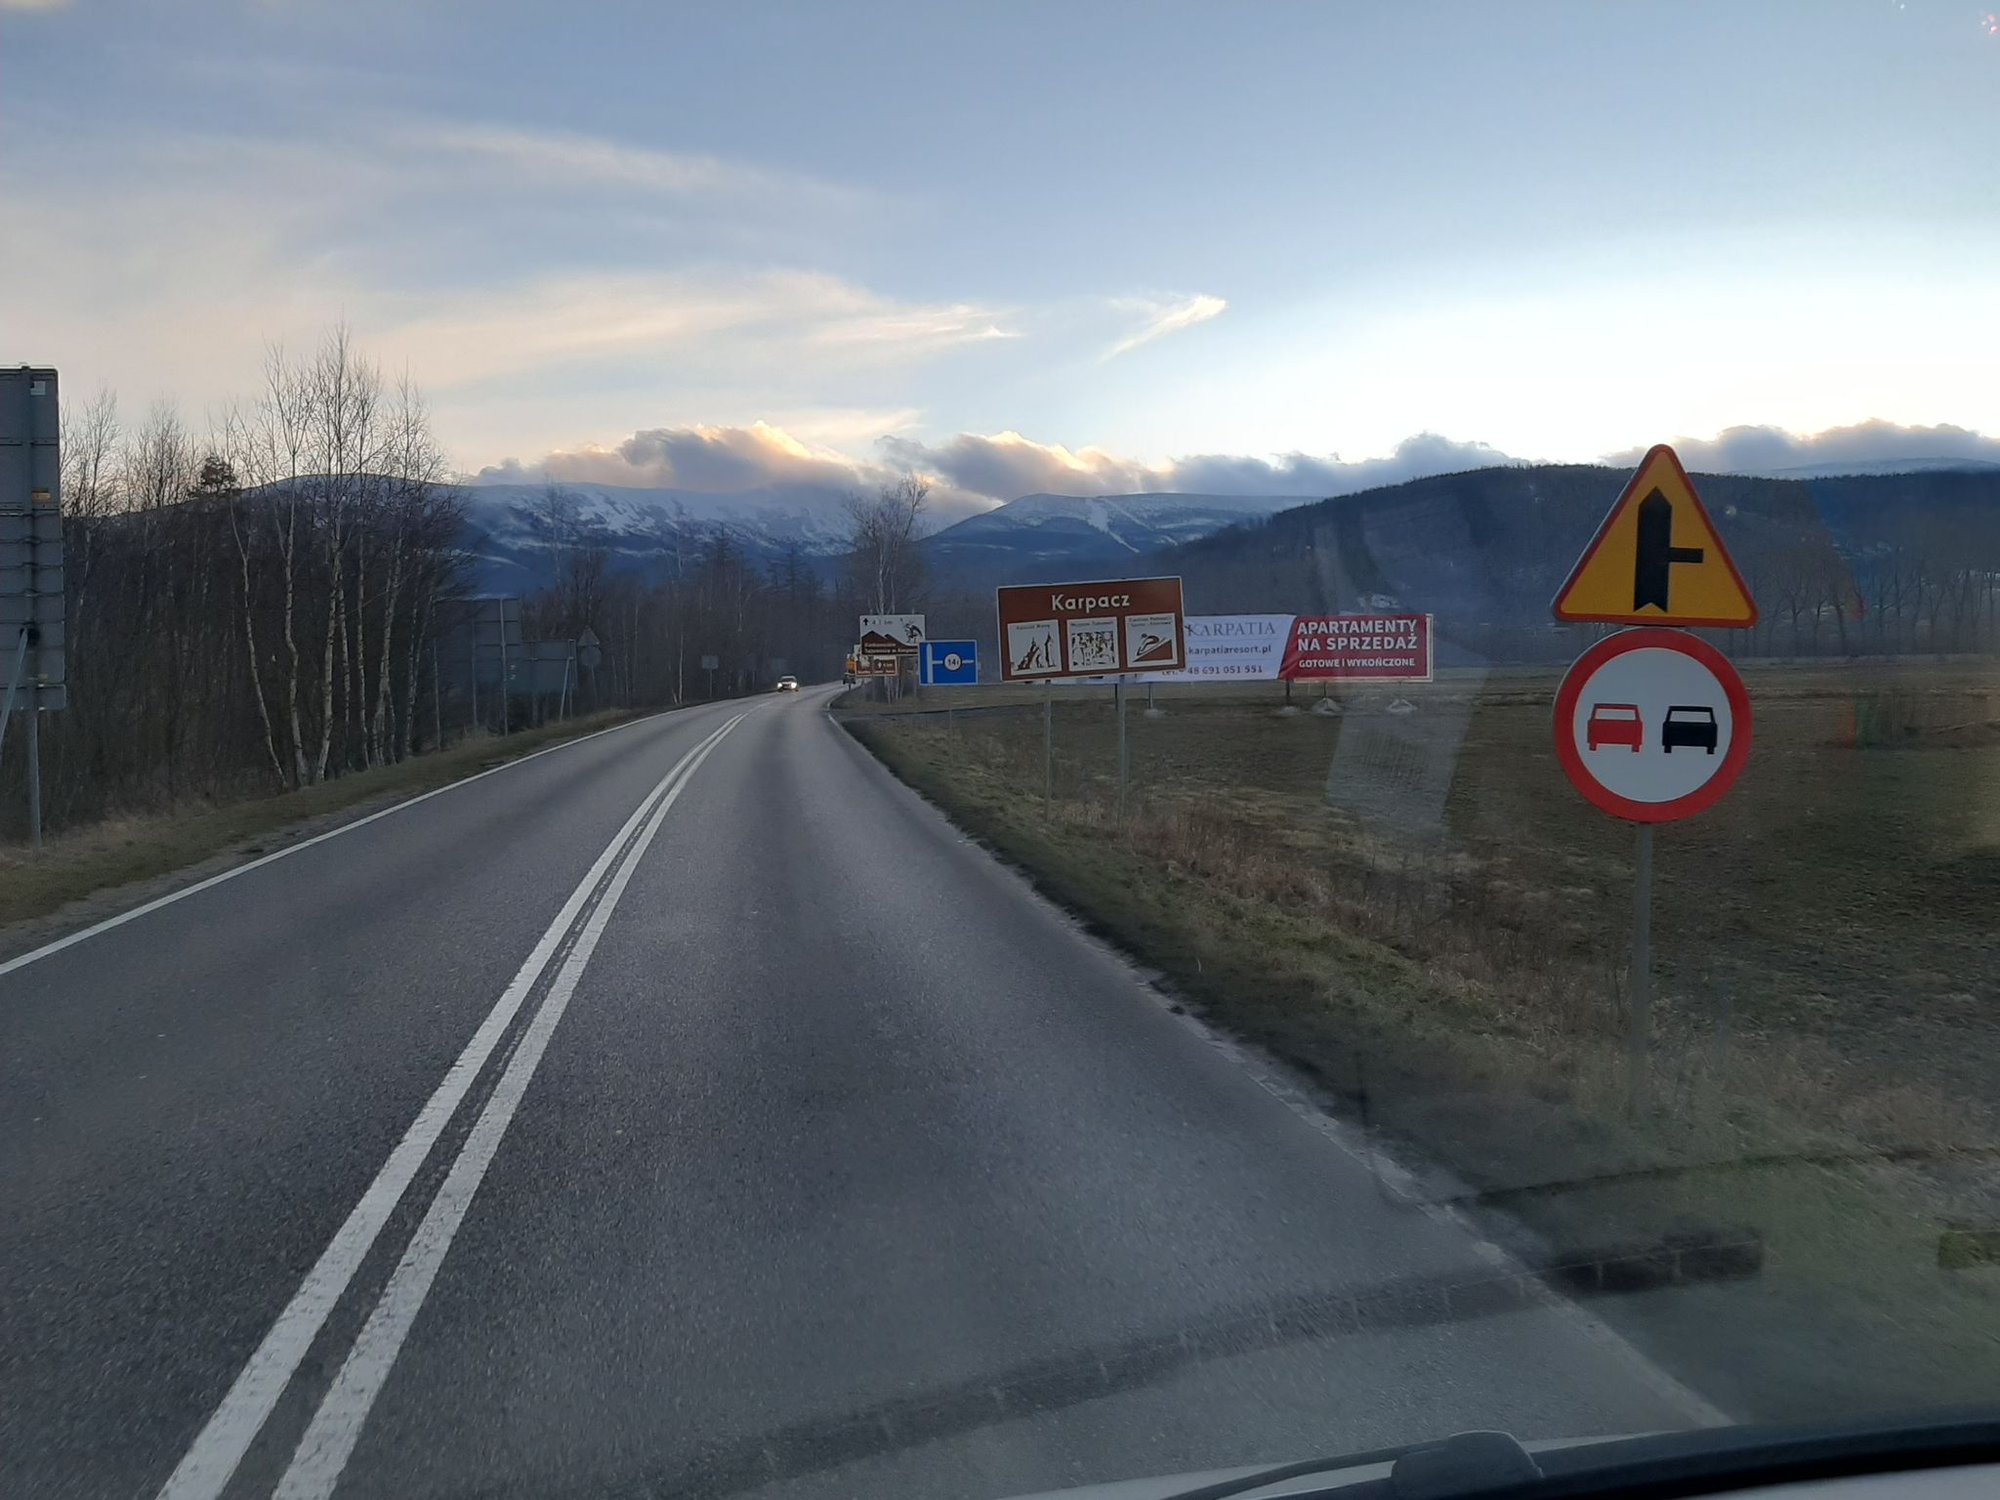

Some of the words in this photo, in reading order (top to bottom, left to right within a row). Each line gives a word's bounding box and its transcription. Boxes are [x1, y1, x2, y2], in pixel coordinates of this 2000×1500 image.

[1051, 594, 1130, 613] Karpacz
[1185, 621, 1276, 637] KARPATIA
[1298, 620, 1417, 634] APARTAMENTY
[1298, 638, 1320, 651] NA
[1327, 633, 1417, 650] SPRZEDAŻ
[1299, 659, 1340, 668] GOTOWE
[1347, 656, 1415, 667] WYKOŃCZONE
